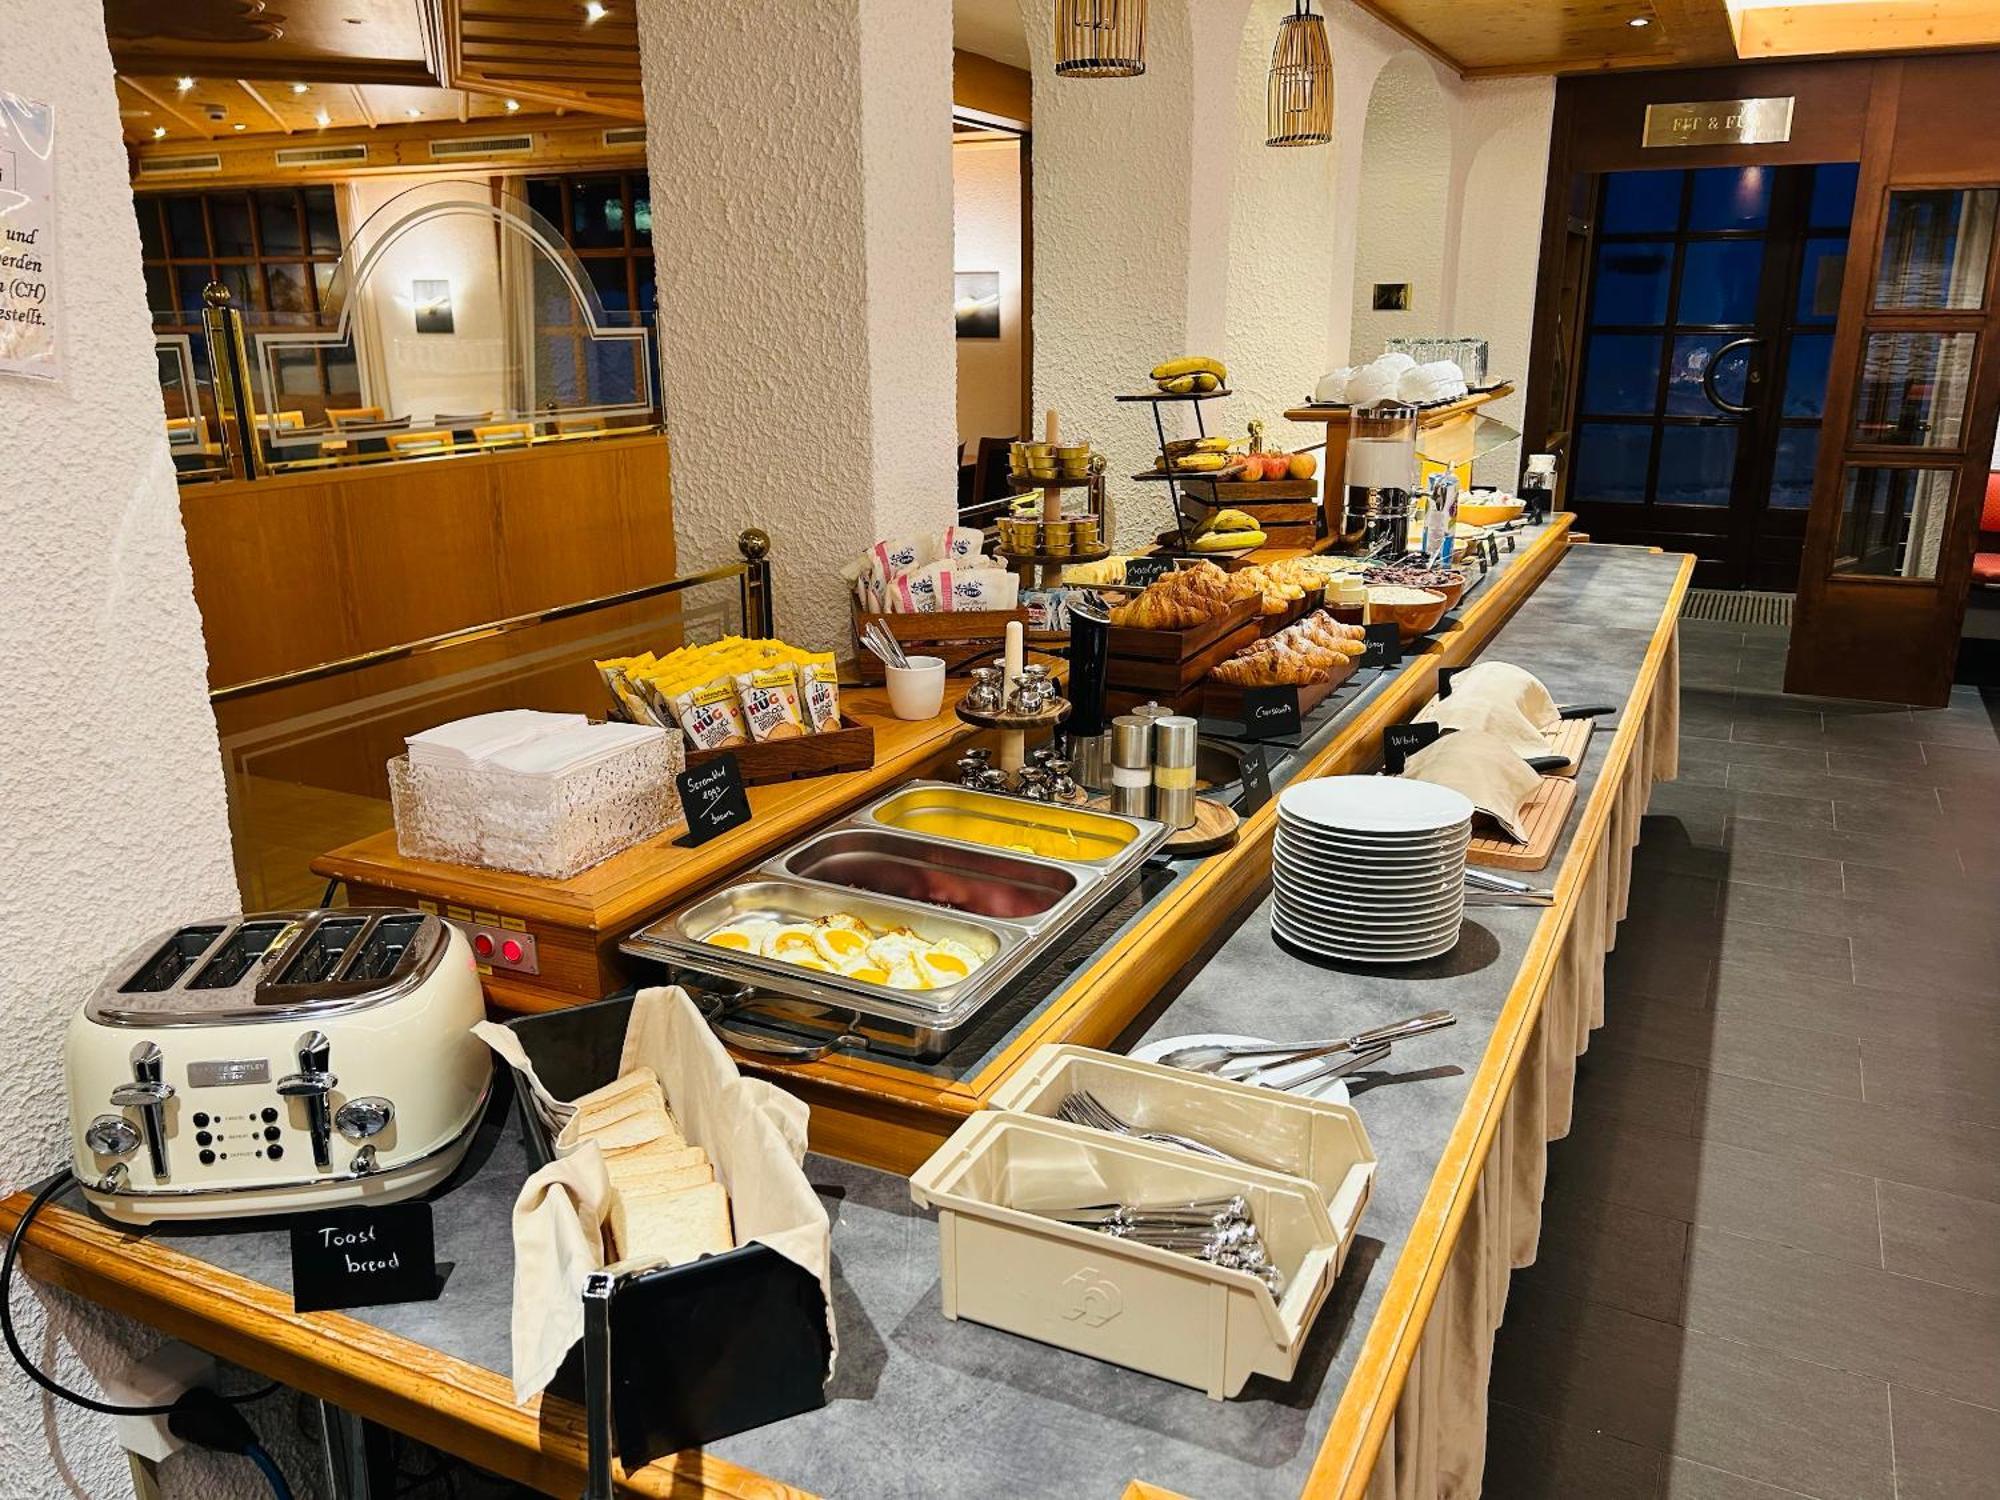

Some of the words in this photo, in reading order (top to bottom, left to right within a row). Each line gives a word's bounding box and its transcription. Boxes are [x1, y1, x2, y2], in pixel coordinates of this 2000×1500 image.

[1707, 117, 1719, 130] &
[6, 228, 39, 244] und
[0, 254, 42, 273] erden
[9, 278, 46, 305] (CH)
[747, 692, 780, 716] HUG
[811, 688, 830, 706] HUG
[692, 707, 724, 735] HUG
[318, 1224, 376, 1248] Toast
[345, 1251, 400, 1273] bread
